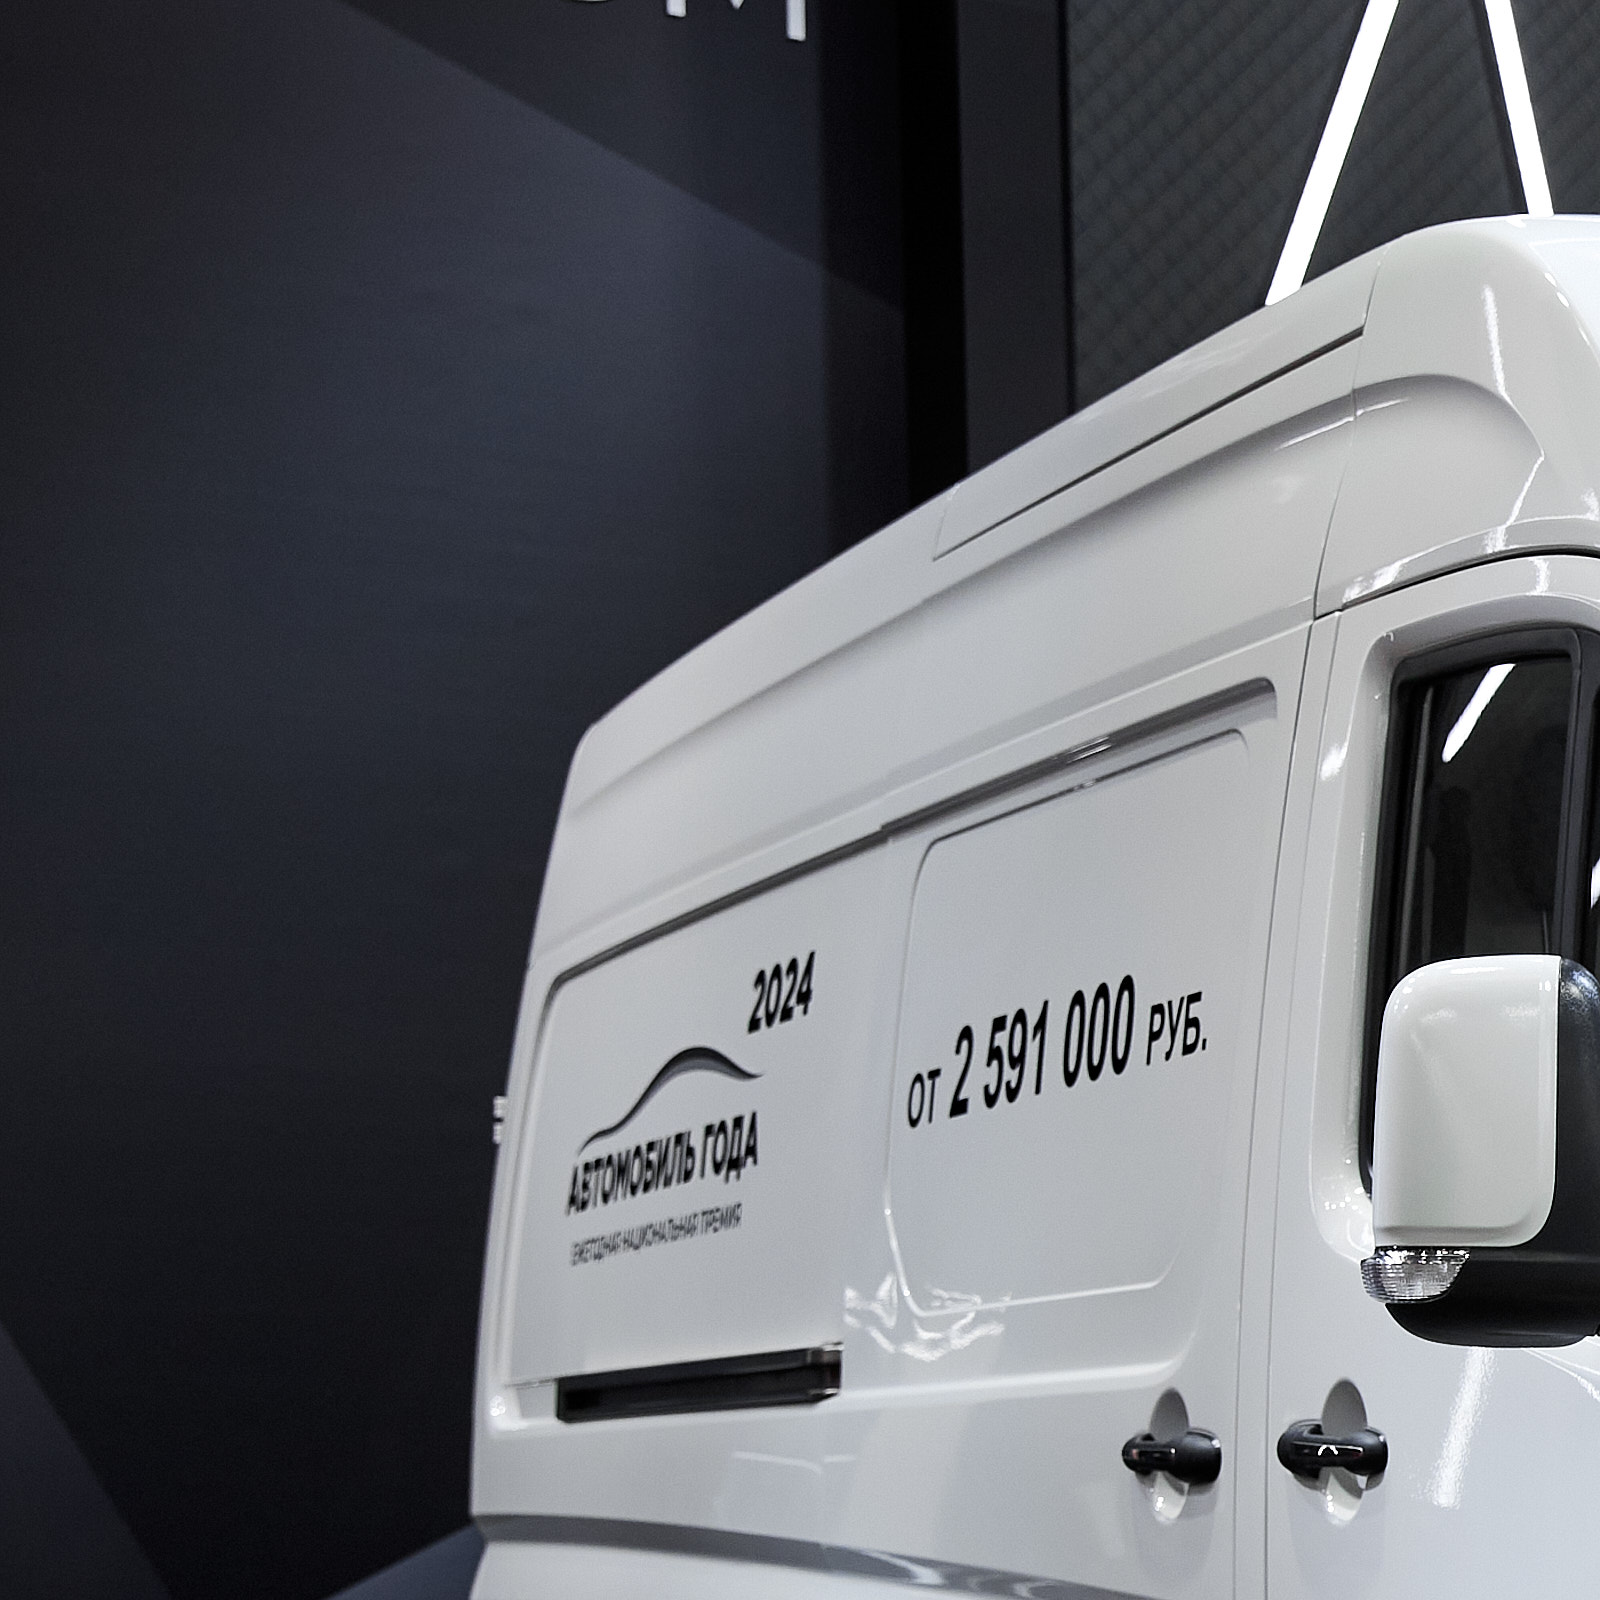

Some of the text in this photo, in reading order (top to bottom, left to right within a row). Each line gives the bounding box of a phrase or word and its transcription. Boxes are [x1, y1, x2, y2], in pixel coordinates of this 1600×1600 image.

[747, 950, 815, 1035] 2024
[907, 974, 1207, 1129] ОТ 2 591 000 РУБ.
[565, 1110, 759, 1216] АВТОМОБИЛЬ ГОДА
